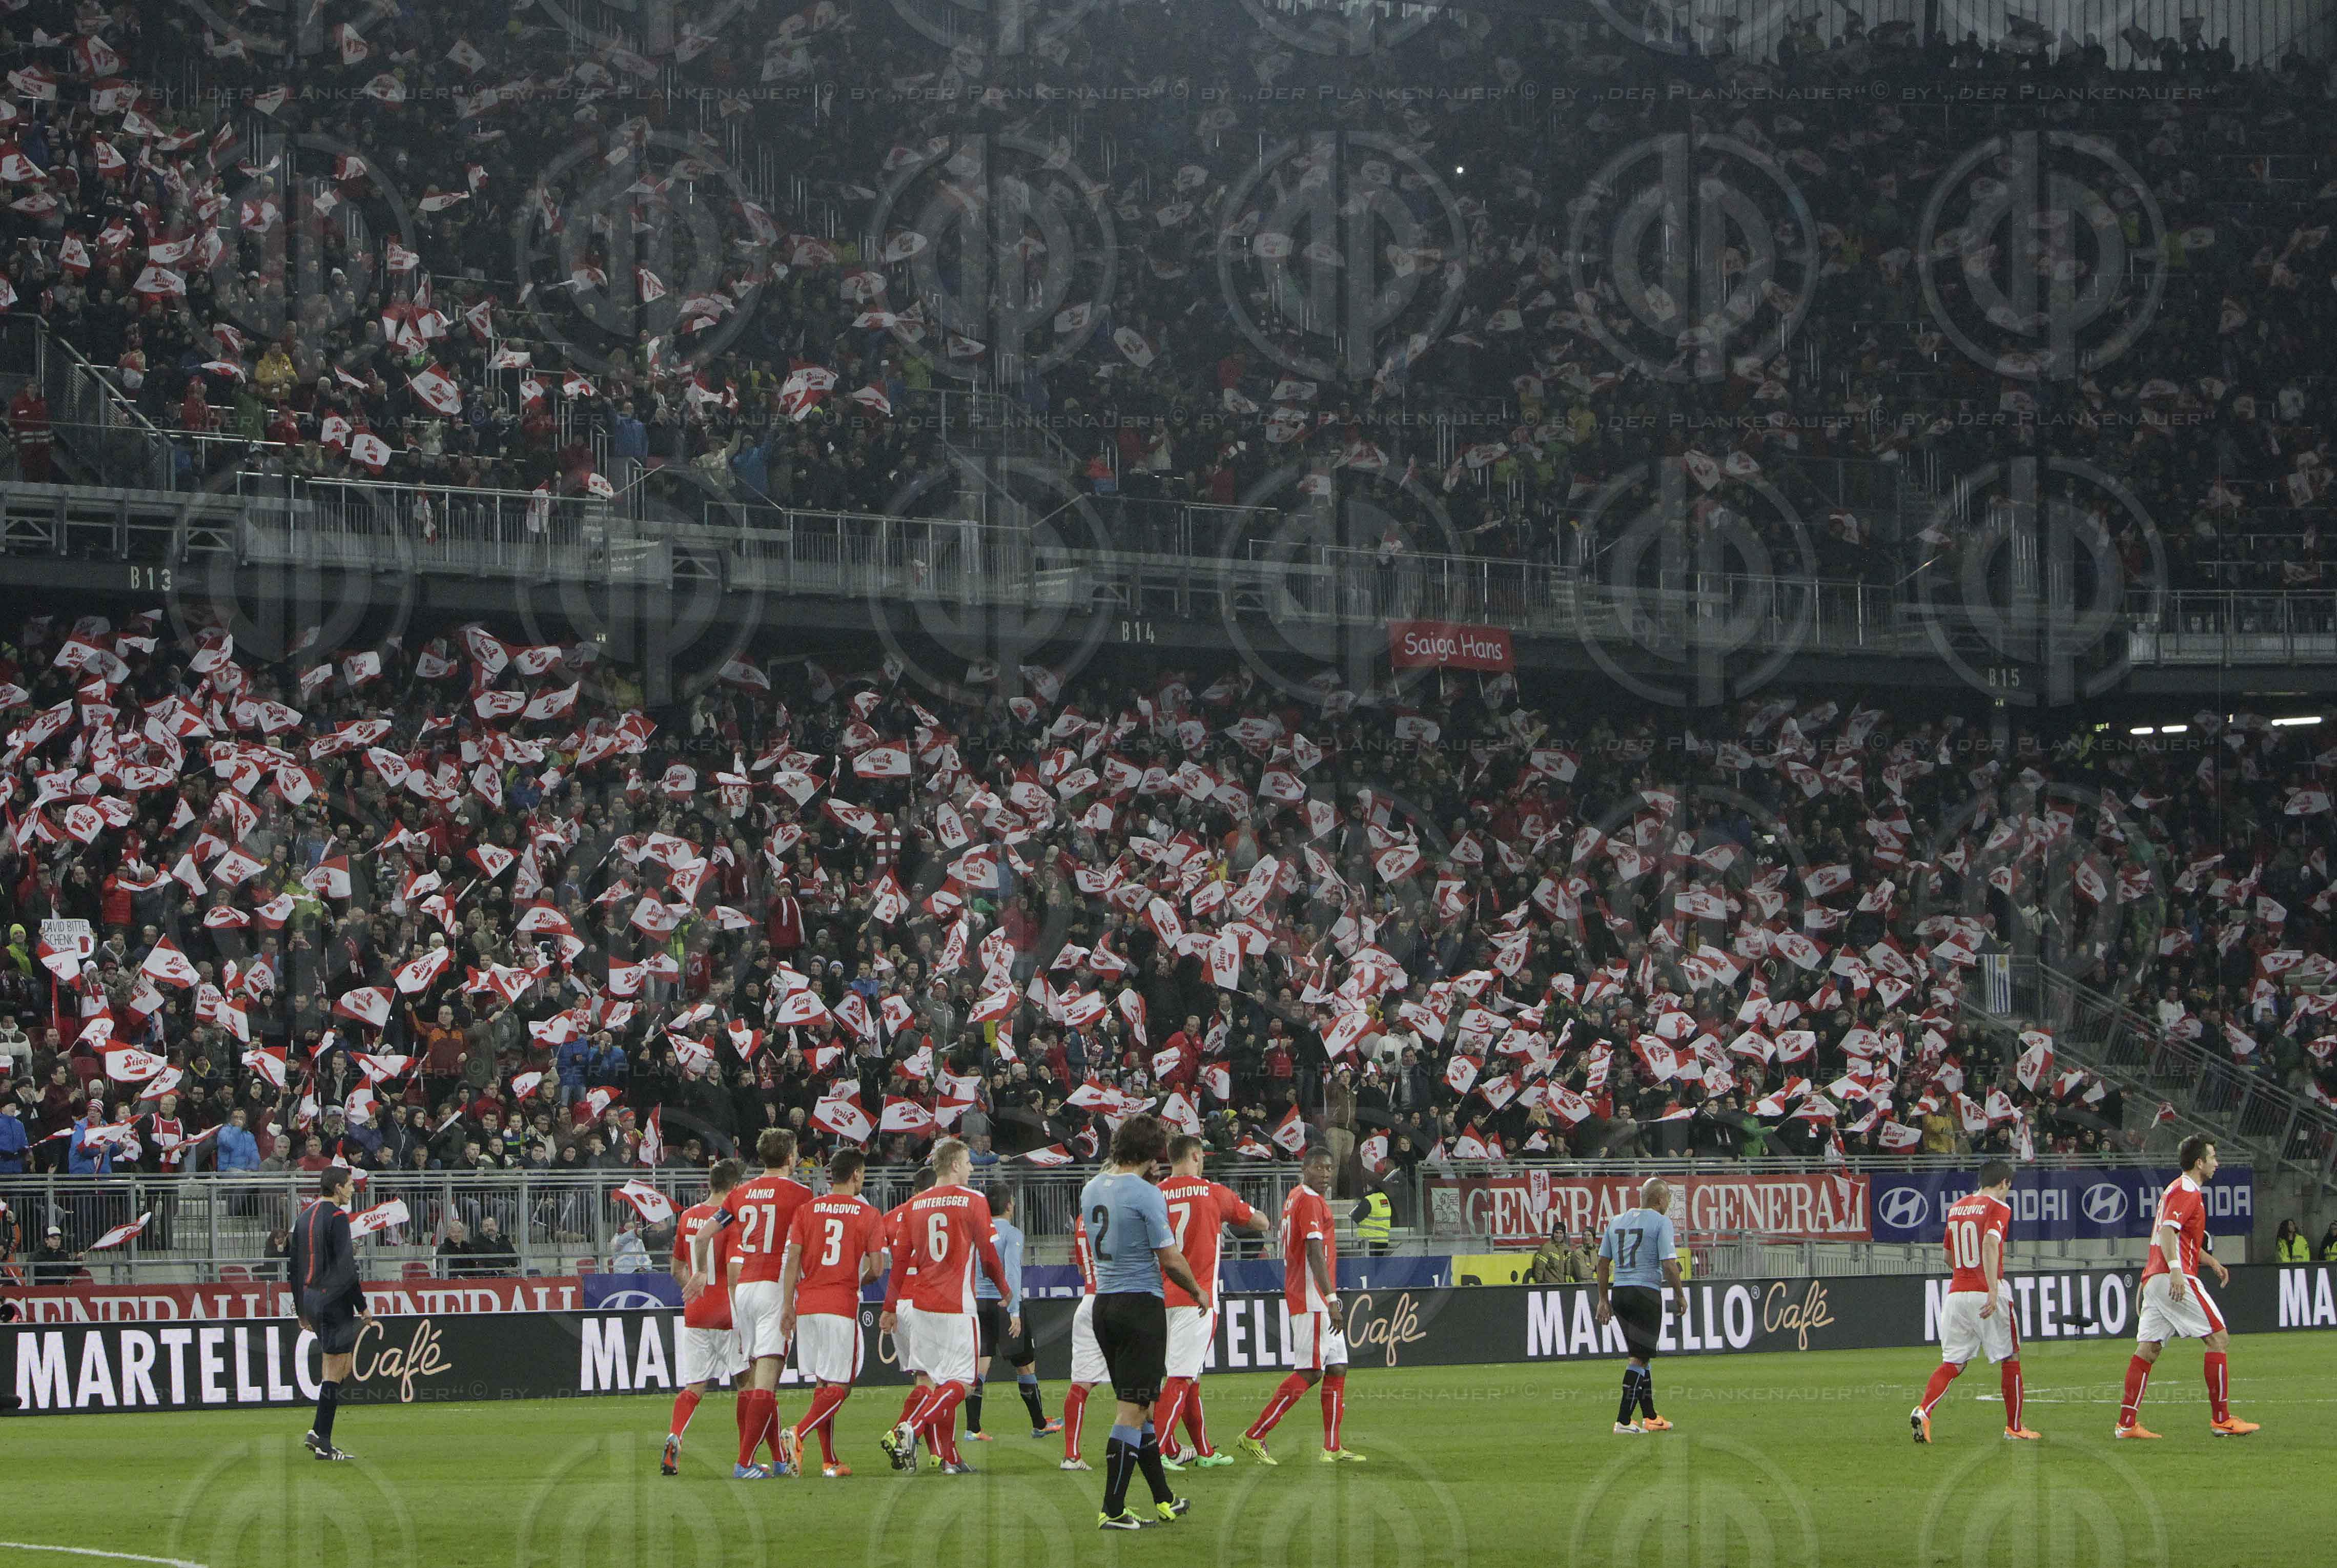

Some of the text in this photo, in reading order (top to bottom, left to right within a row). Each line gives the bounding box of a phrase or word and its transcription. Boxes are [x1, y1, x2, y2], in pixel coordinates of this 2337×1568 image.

[1404, 632, 1503, 662] Saiga Hans
[44, 920, 87, 932] DAVID BITTE
[44, 934, 74, 945] SCHENK
[123, 1054, 152, 1069] Stiegl
[745, 1188, 775, 1199] JANKO
[814, 1203, 861, 1215] DRAGOVIC
[912, 1196, 969, 1210] HINTEREGGER
[1162, 1185, 1209, 1201] NAUTOVIC
[1692, 1182, 1866, 1234] GENERAI
[739, 1205, 776, 1253] 21
[821, 1219, 844, 1266] 3
[928, 1212, 949, 1262] 6
[1092, 1205, 1112, 1261] 2
[1169, 1202, 1191, 1252] 7
[1614, 1228, 1643, 1268] 17
[1948, 1221, 1980, 1269] 10
[1347, 1292, 1426, 1366] Café
[1527, 1280, 1835, 1356] MAELLO Café
[352, 1319, 452, 1402] Café
